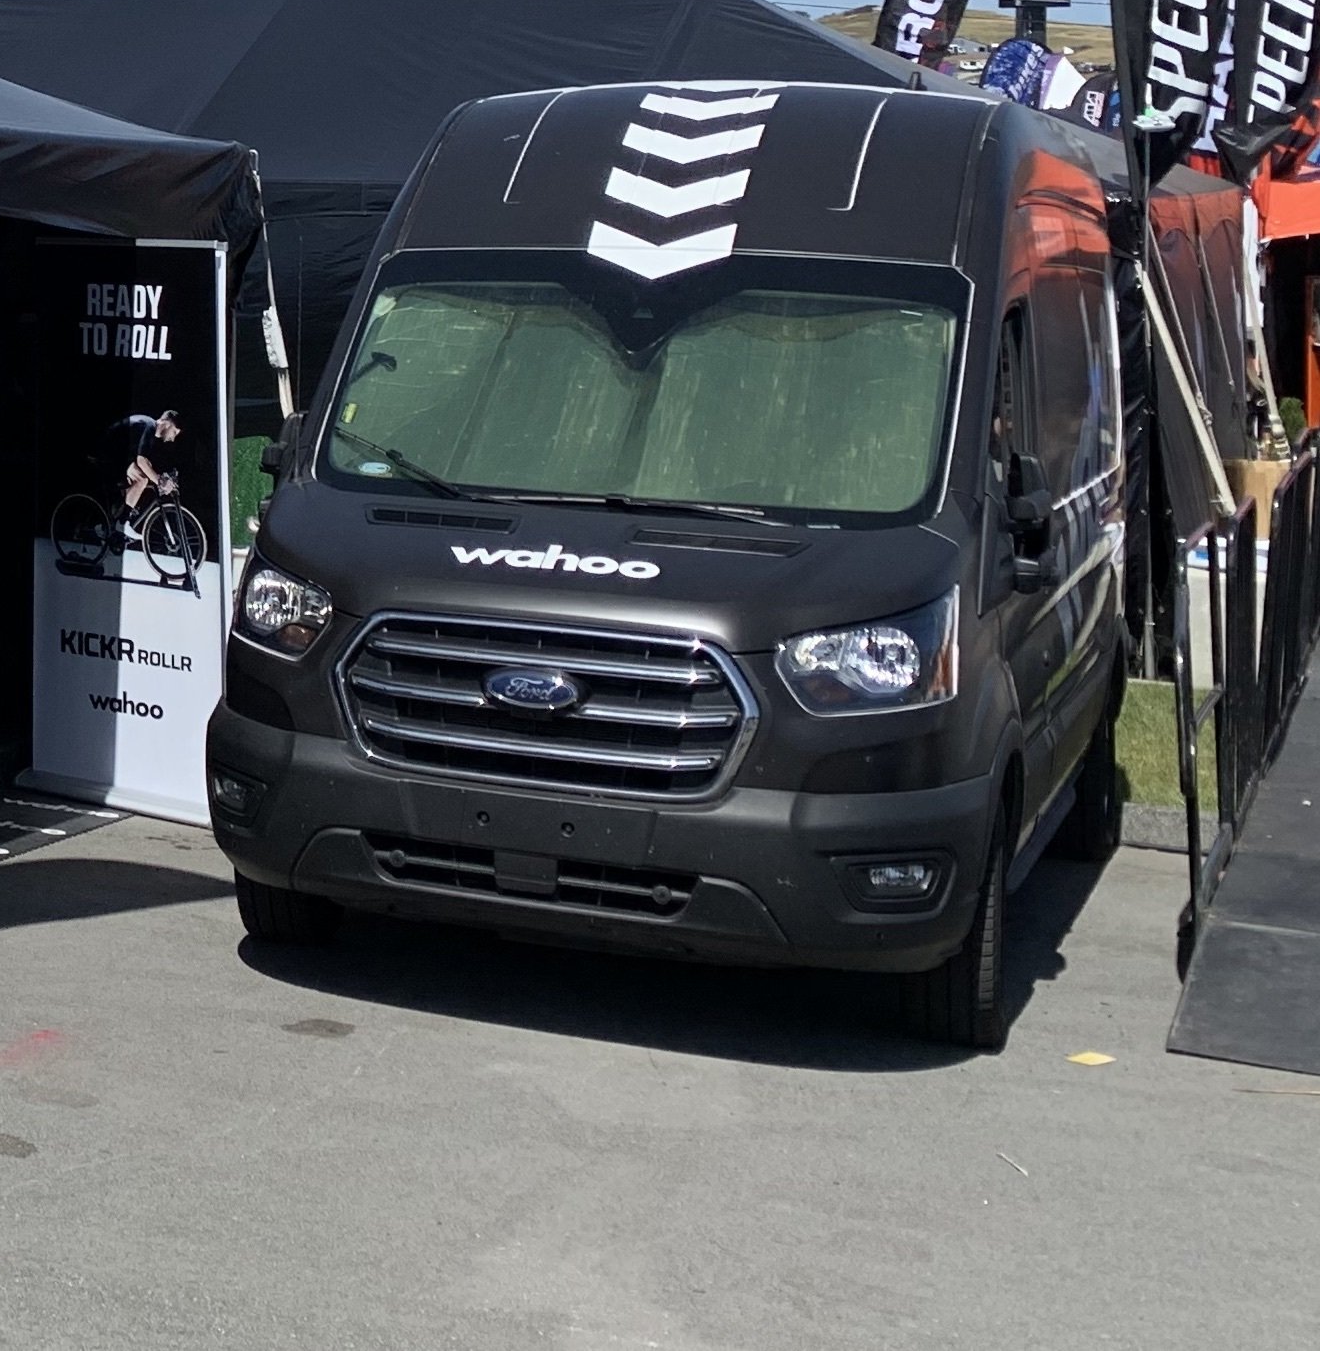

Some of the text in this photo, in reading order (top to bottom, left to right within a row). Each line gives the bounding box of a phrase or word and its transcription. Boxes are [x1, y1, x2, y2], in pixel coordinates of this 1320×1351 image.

[86, 283, 163, 320] READY
[79, 321, 172, 361] TO ROLL
[450, 544, 661, 579] wahoo
[60, 628, 192, 673] KICKR ROLLR
[88, 690, 164, 720] wahoo
[504, 676, 556, 701] Ford
